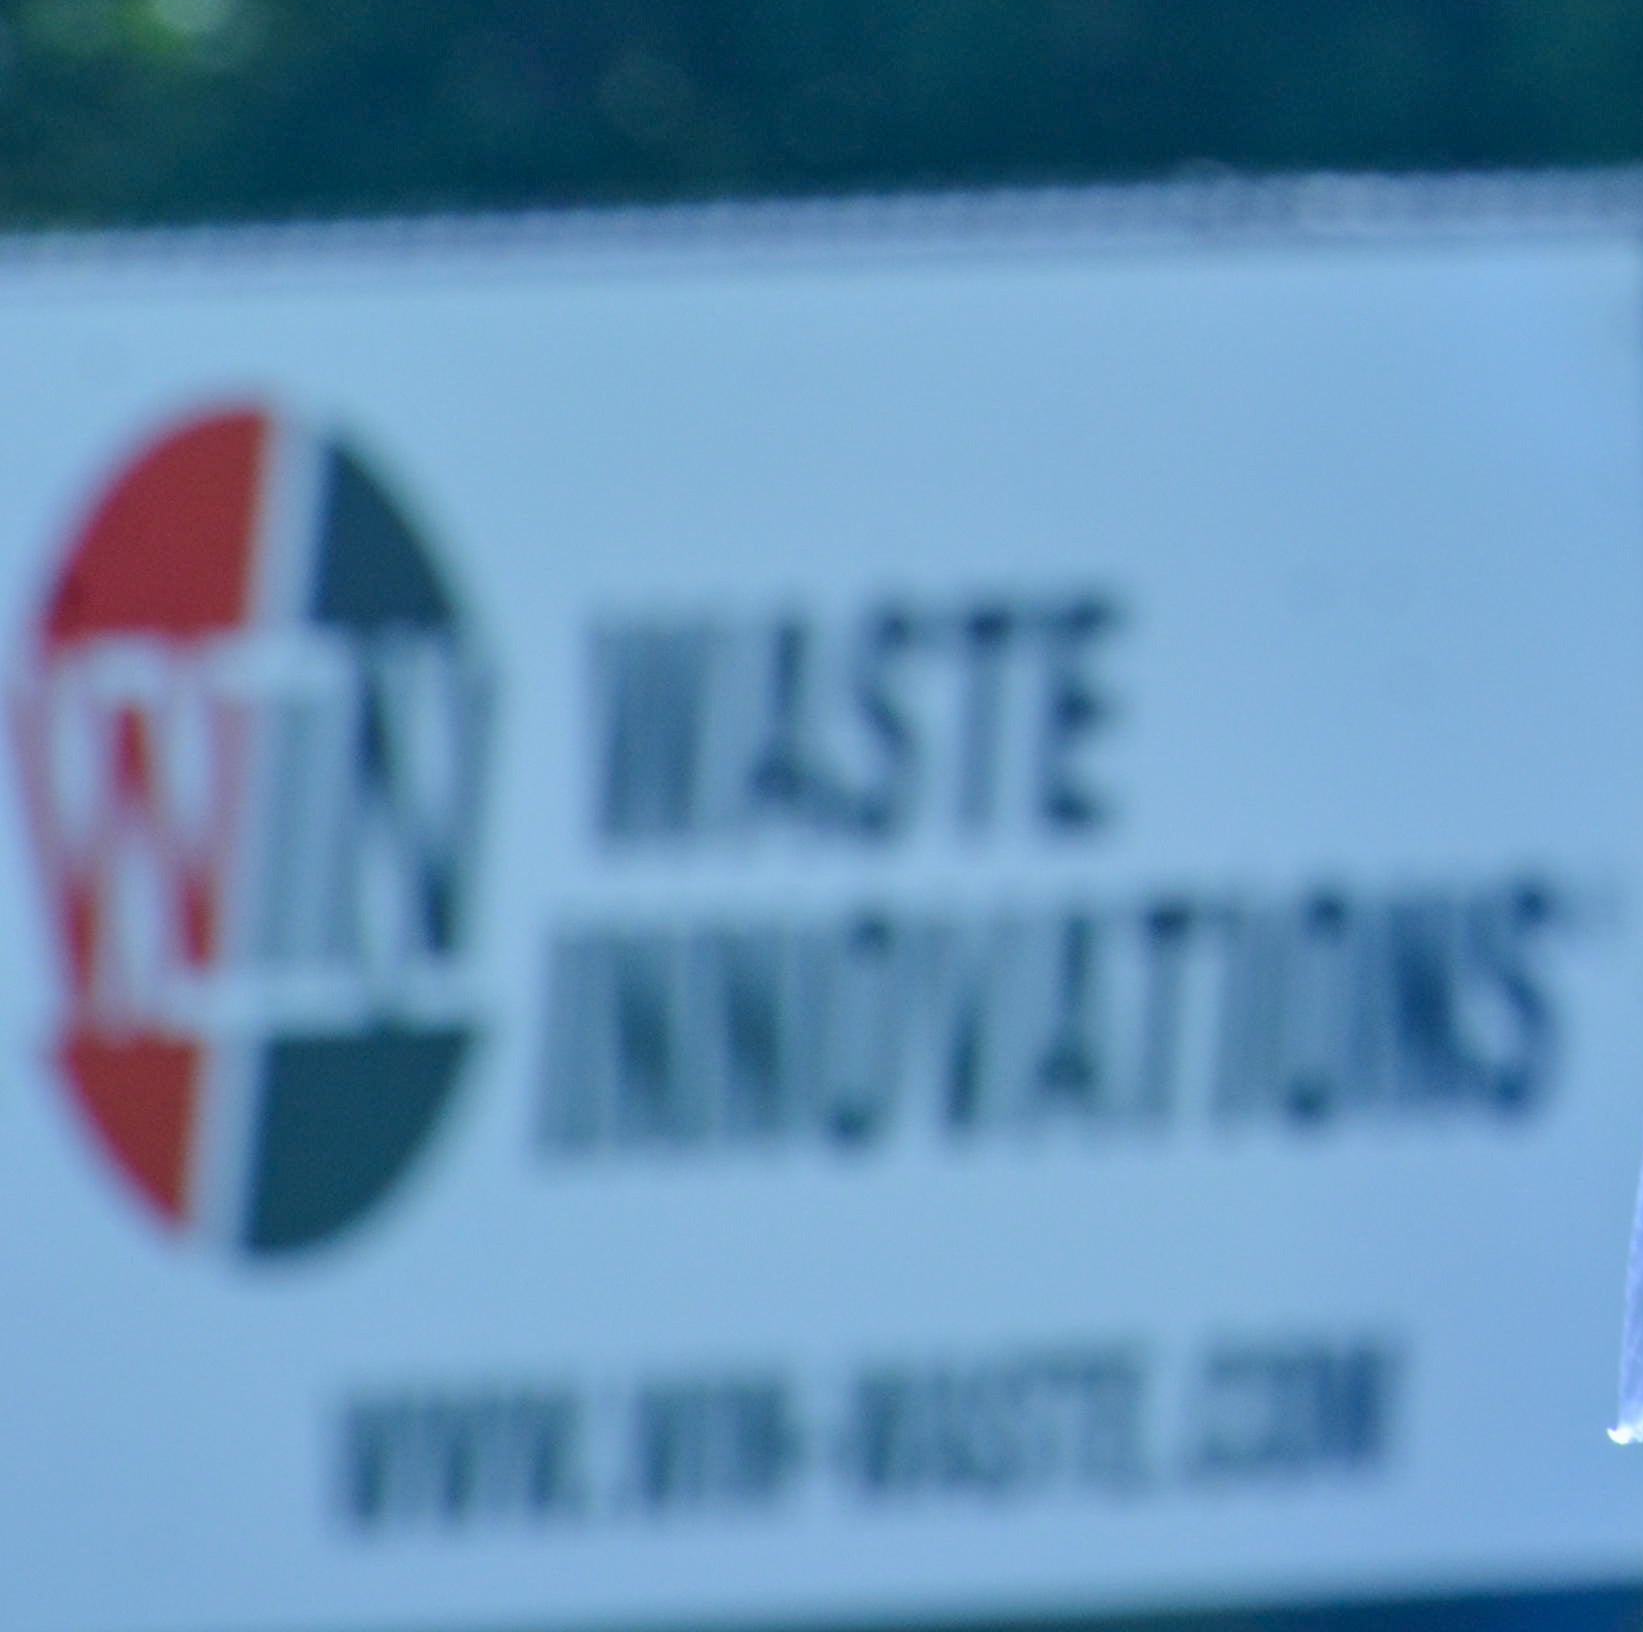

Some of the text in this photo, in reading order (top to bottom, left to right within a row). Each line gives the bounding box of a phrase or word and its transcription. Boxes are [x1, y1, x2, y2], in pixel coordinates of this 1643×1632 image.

[12, 630, 498, 1040] WIN
[588, 590, 1125, 853] WASTE
[535, 866, 1575, 1158] INNOVATIONS
